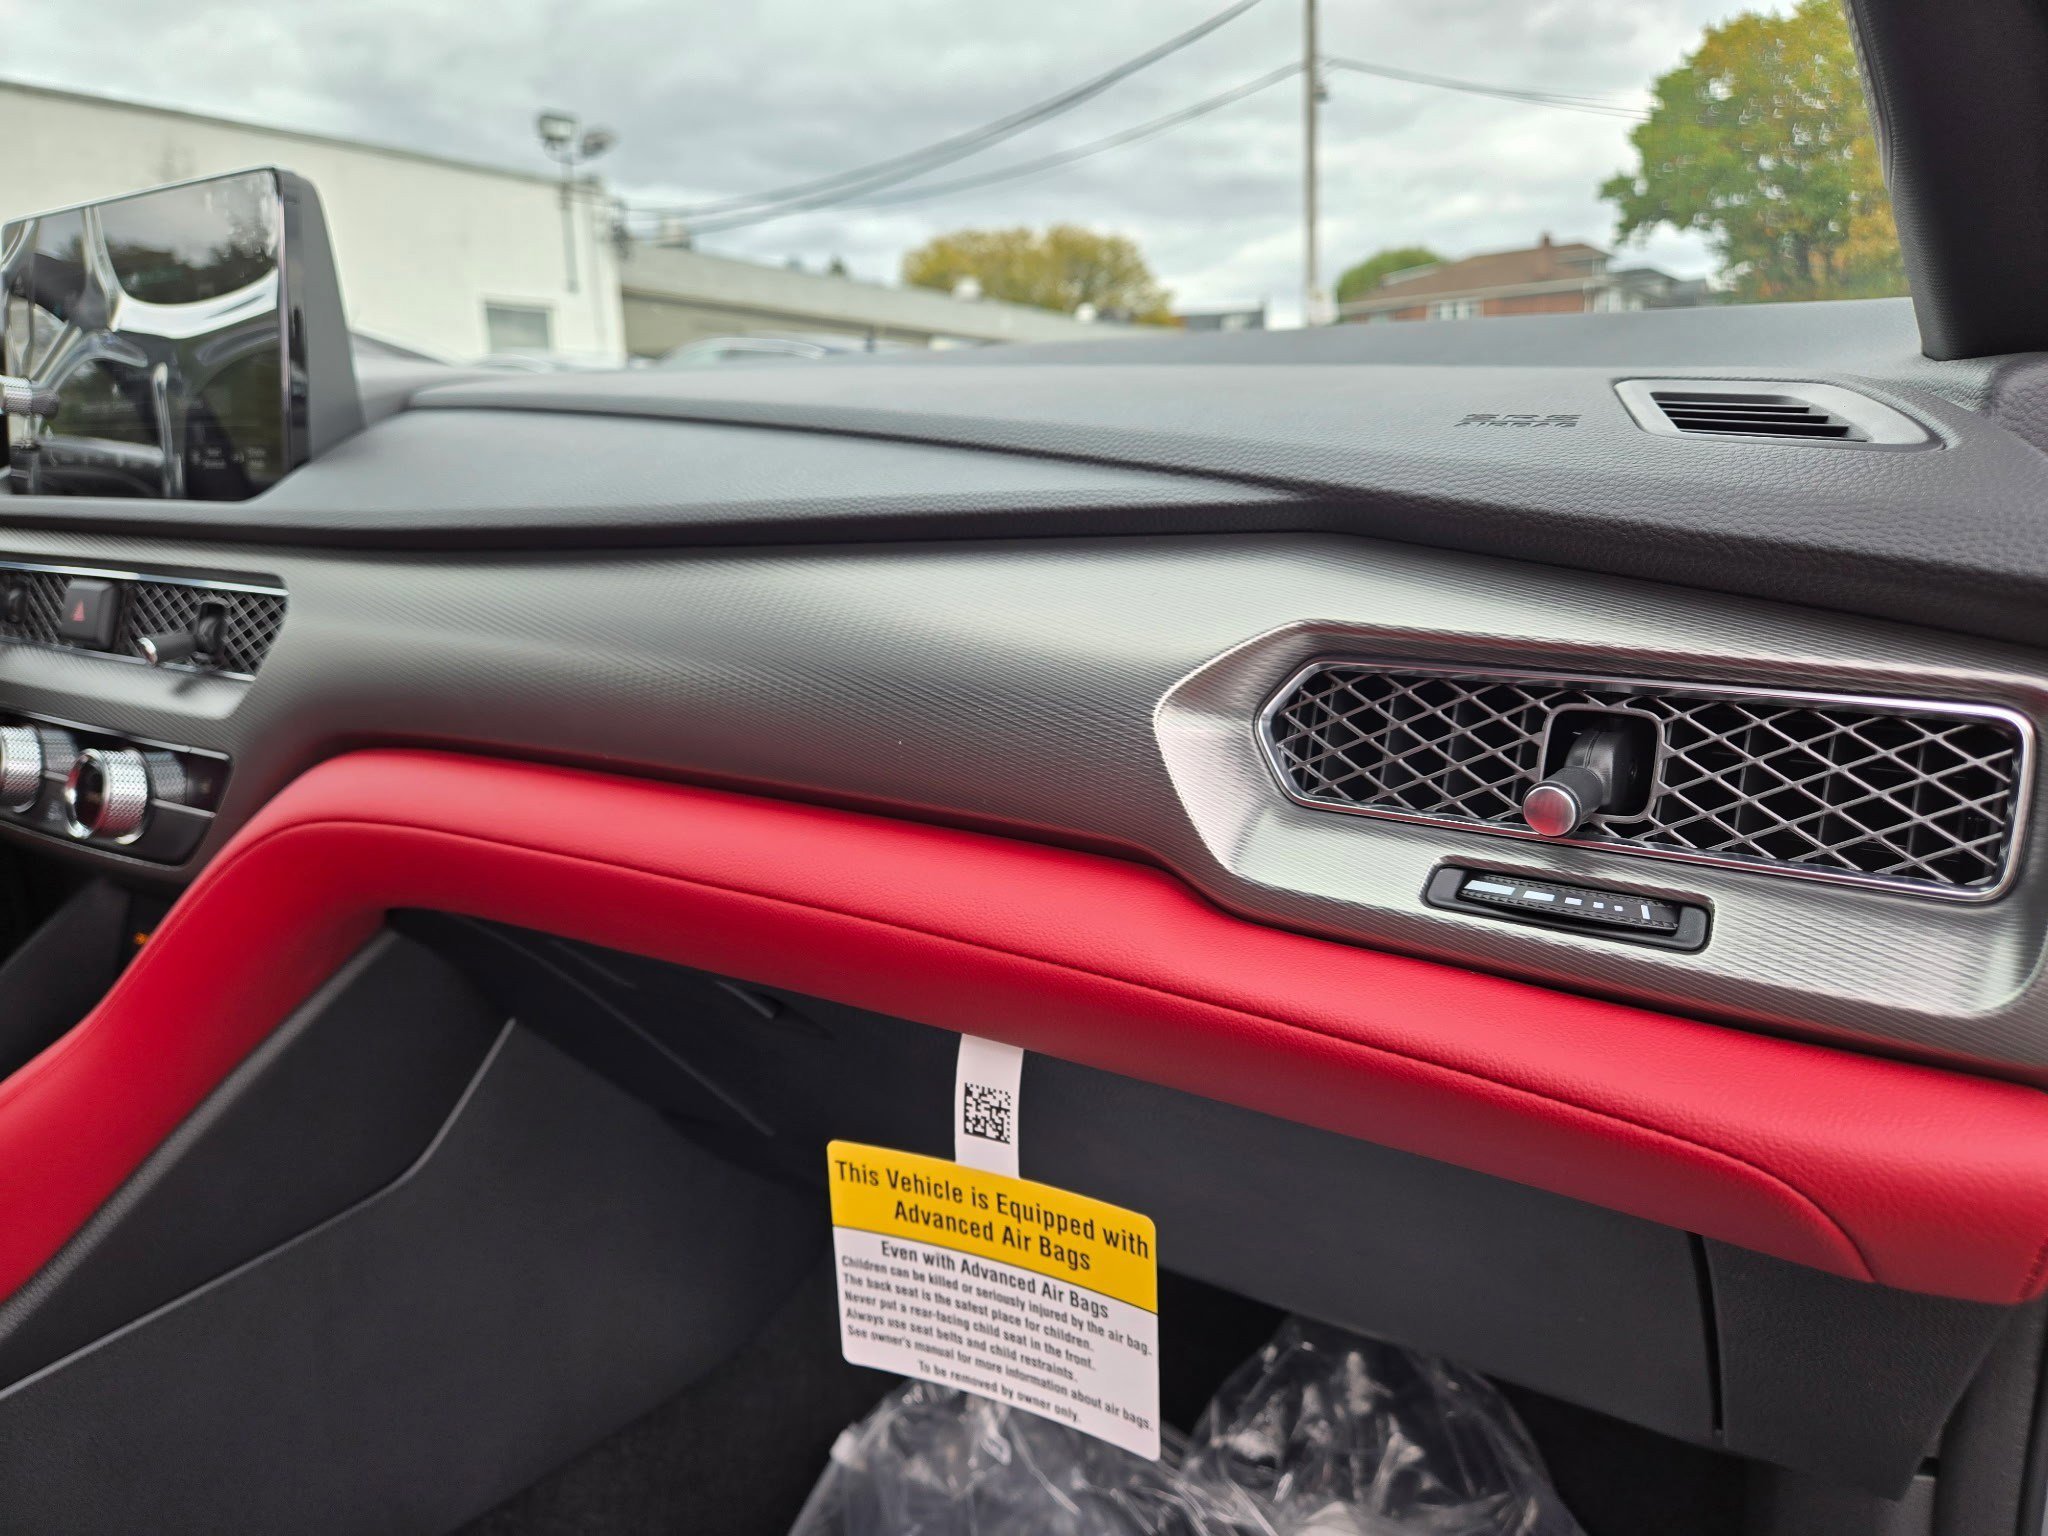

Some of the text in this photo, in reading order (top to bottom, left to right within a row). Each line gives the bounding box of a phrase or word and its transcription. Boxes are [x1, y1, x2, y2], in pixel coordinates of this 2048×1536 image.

[835, 1160, 1149, 1259] This Vehicle is Equipped with
[895, 1200, 1090, 1271] Advanced Air Bags
[842, 1255, 1152, 1356] Children can be killed or seriously injured by the air bag.
[844, 1272, 1094, 1351] The back seat is the safest place for children.
[881, 1240, 1109, 1318] Even with Advanced Air Bags
[845, 1290, 1096, 1371] Never put a rear-facing child seat in the front.
[846, 1308, 1078, 1382] Always use seat belts and child restraints.
[847, 1324, 1154, 1432] See owner's manual for more information about air bags.
[918, 1359, 931, 1373] To
[933, 1364, 947, 1377] be
[950, 1370, 998, 1392] removed
[1001, 1384, 1013, 1399] by
[1017, 1392, 1051, 1409] owner
